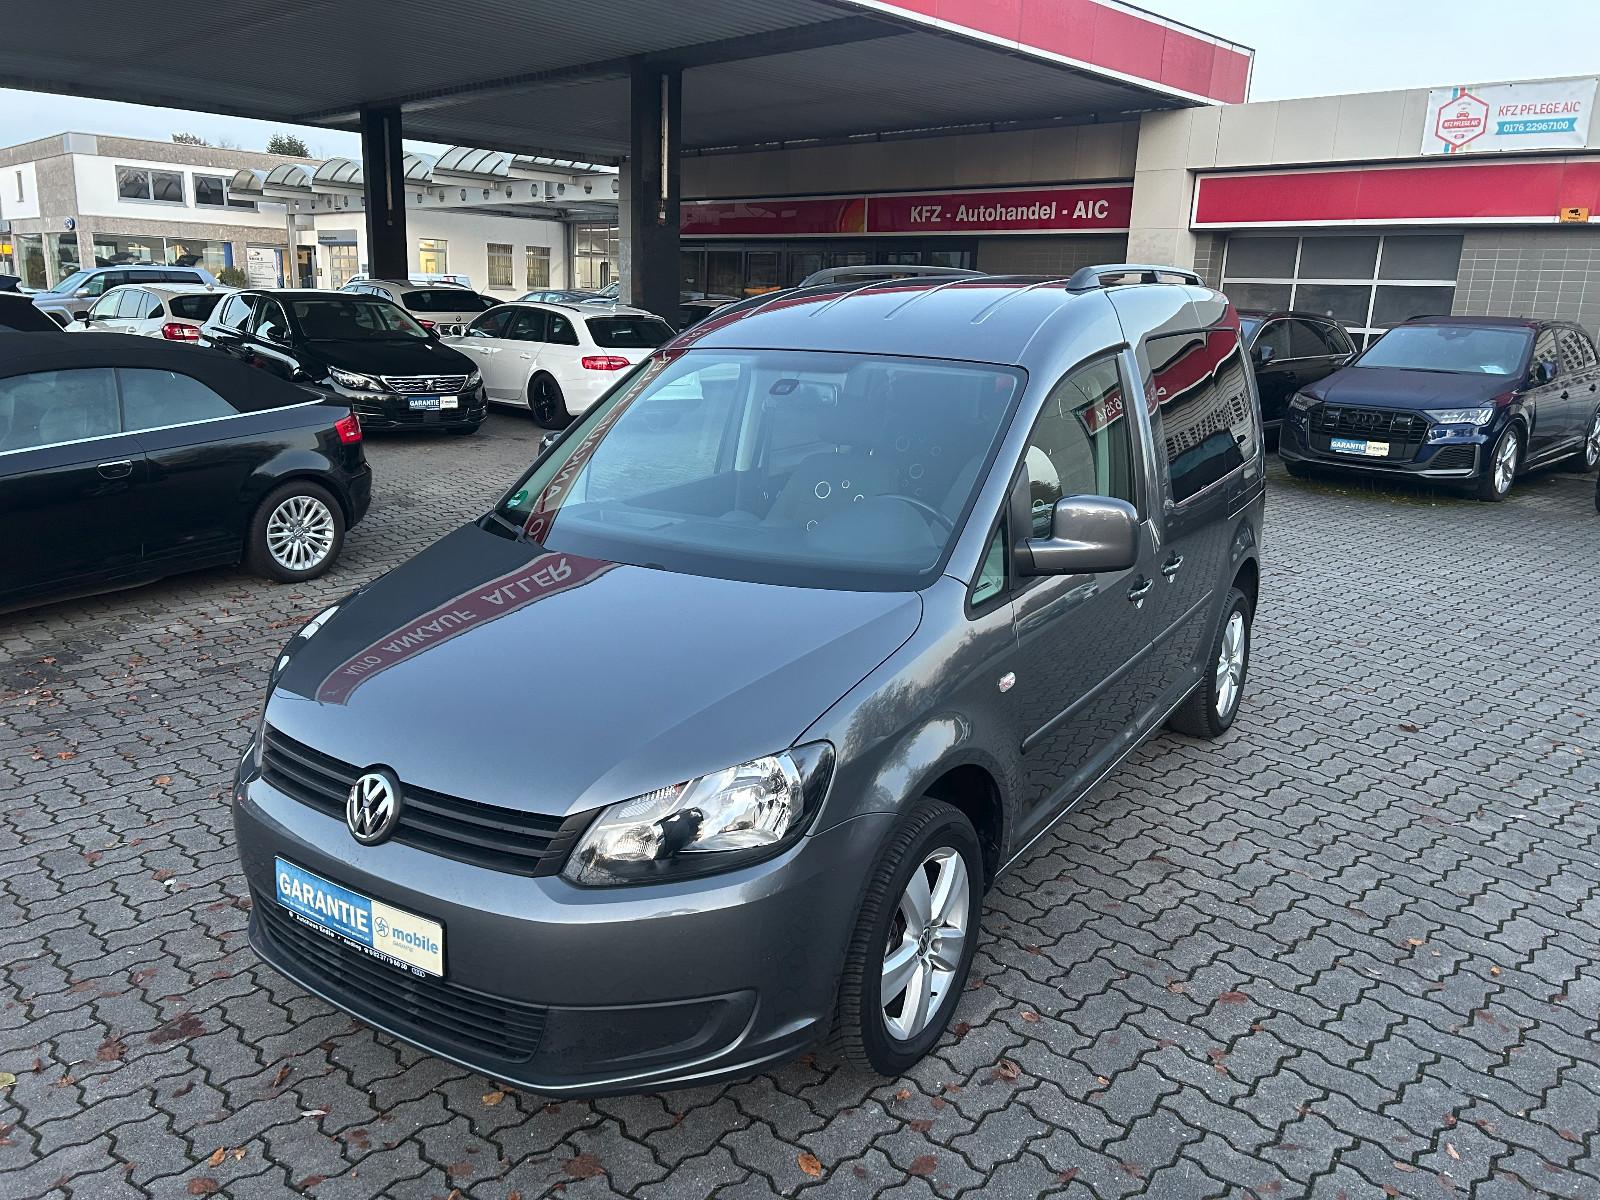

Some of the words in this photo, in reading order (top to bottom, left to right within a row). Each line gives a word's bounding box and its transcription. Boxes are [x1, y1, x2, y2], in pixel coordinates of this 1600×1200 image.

[1498, 104, 1518, 117] KFZ
[1520, 103, 1560, 115] PFLEGE
[1561, 101, 1581, 113] AIC
[1503, 122, 1524, 132] 0176
[1526, 121, 1569, 131] 22967100
[910, 206, 942, 222] KFZ
[956, 202, 1056, 222] Autohandel
[1072, 200, 1109, 219] AIC
[409, 399, 439, 407] GARANTIE
[1331, 441, 1365, 450] GARANTIE
[279, 872, 369, 933] GARANTIE
[393, 926, 439, 954] mobile
